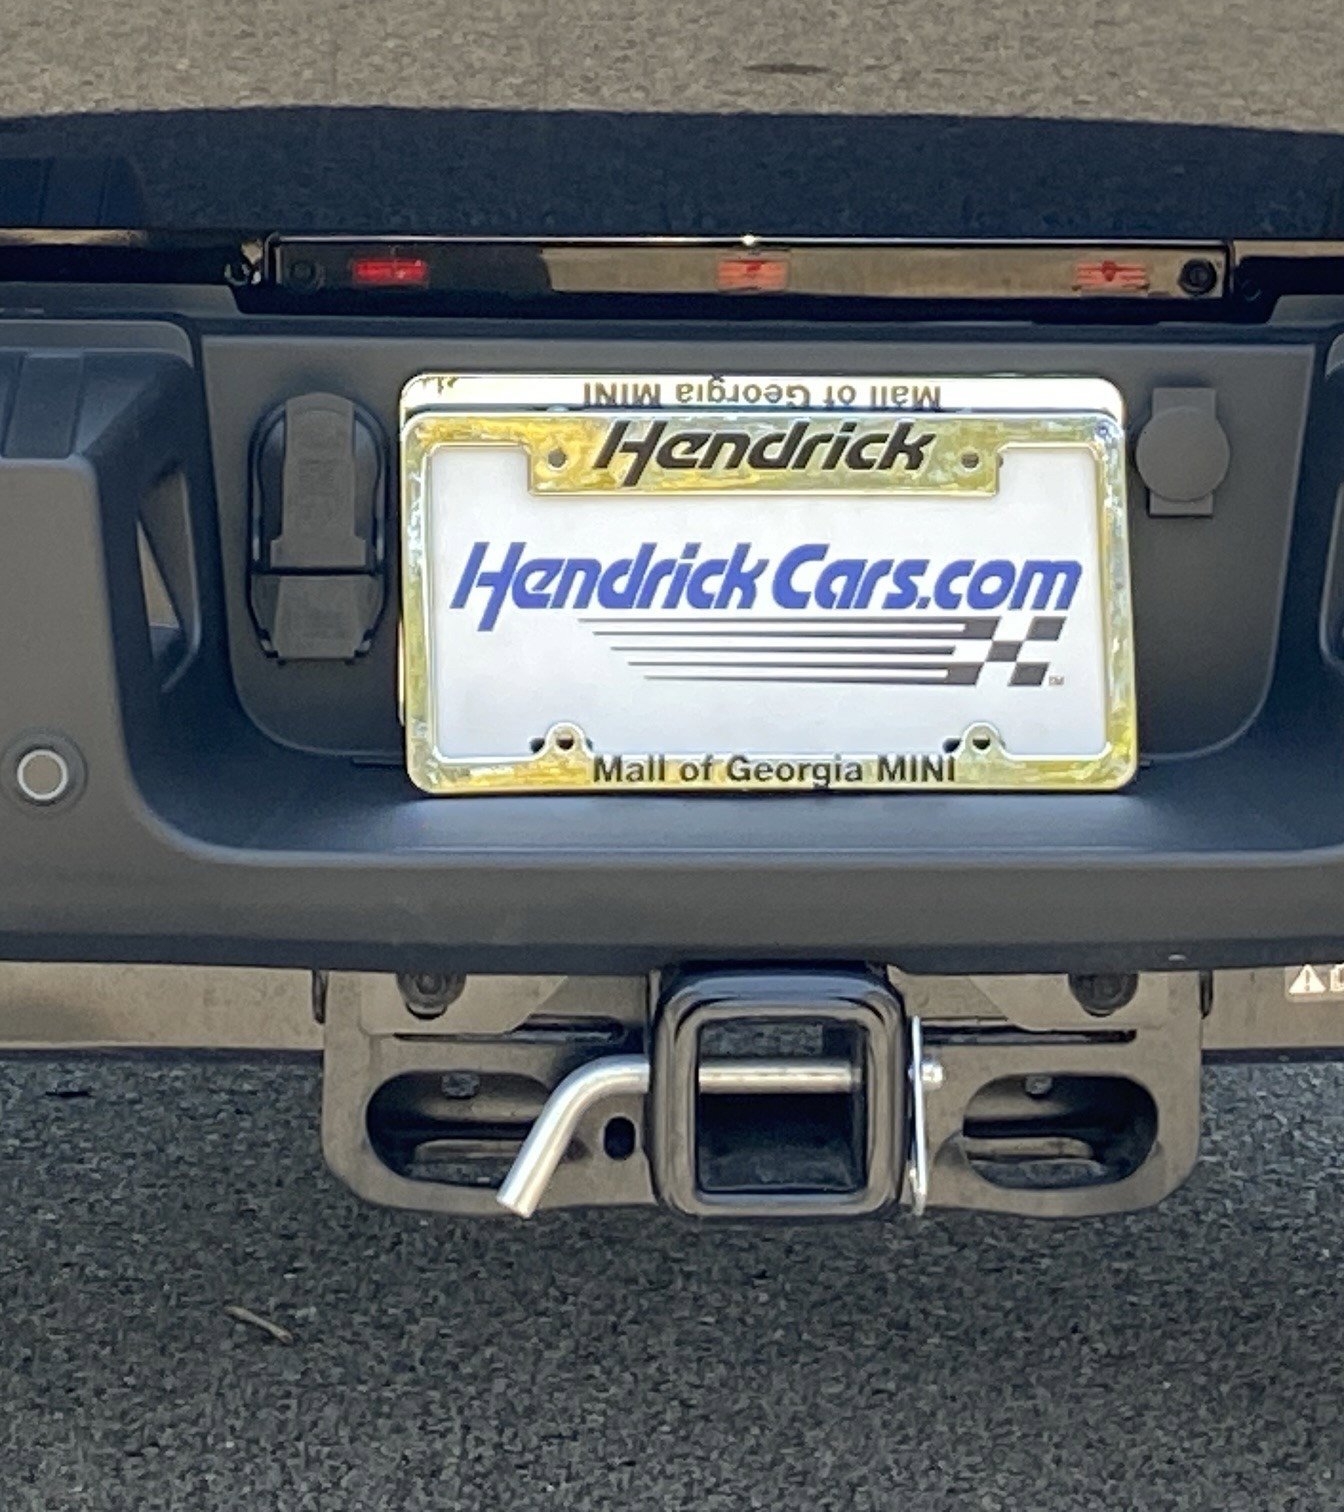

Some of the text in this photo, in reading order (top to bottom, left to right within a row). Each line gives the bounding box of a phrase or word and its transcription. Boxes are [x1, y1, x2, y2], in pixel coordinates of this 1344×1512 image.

[824, 384, 858, 407] of
[870, 384, 943, 412] Mall
[592, 420, 938, 489] Hendrick
[592, 753, 956, 789] Mall of Georgia MINI
